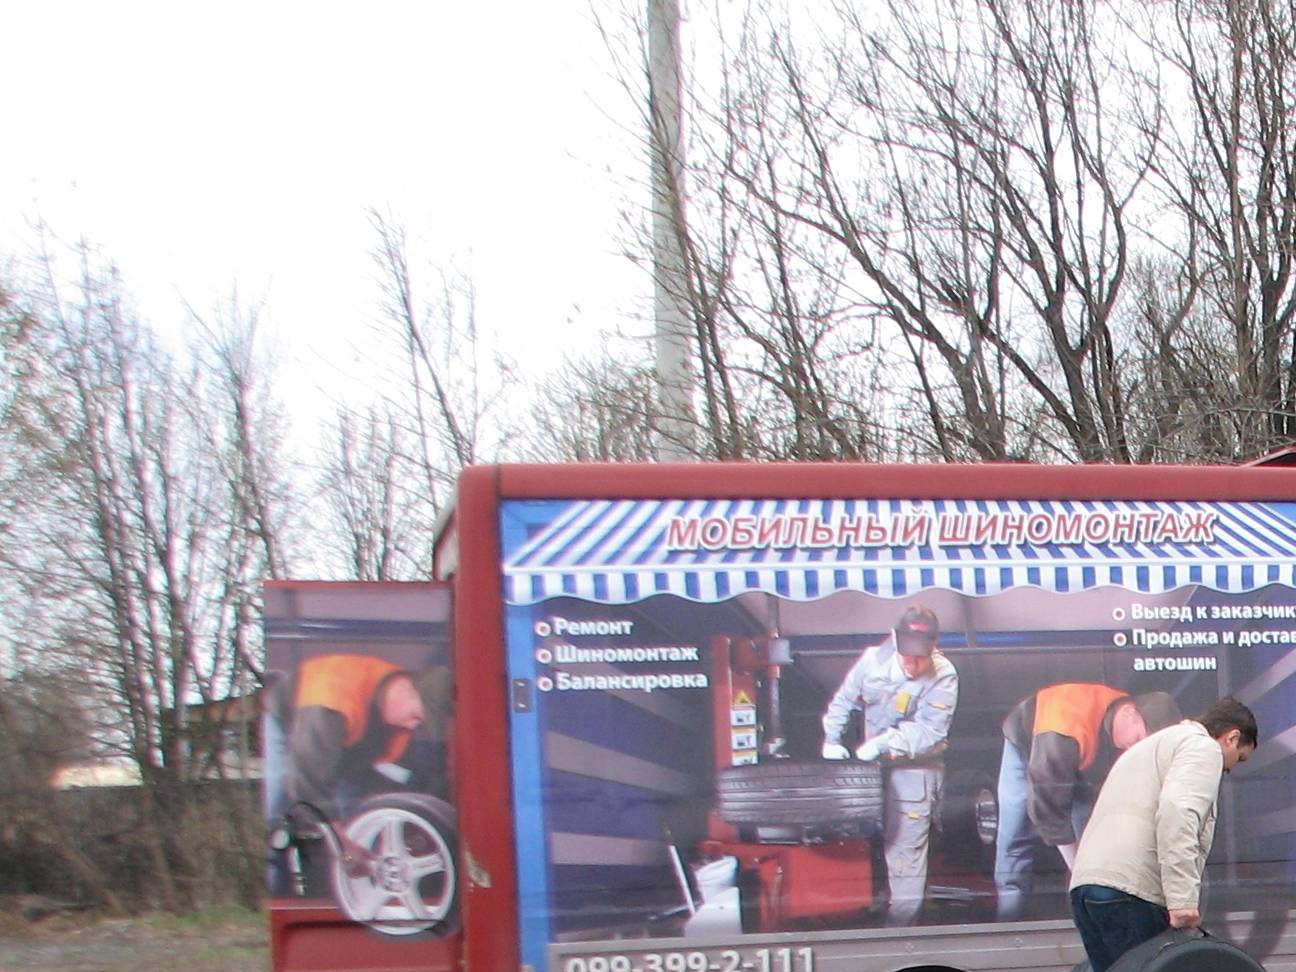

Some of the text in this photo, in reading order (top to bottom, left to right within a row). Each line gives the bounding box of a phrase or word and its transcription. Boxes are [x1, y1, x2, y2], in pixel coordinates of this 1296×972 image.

[666, 508, 1216, 550] МОБИЛЬНЫЙ ШИНОМОНТАЖ
[1131, 604, 1192, 623] Выезд
[1196, 607, 1207, 619] к
[555, 618, 634, 636] Ремонт
[1132, 629, 1218, 649] Продажа
[1223, 632, 1234, 644] и
[555, 644, 699, 664] Шиномонтаж
[1133, 655, 1217, 671] автошин
[556, 672, 708, 693] Балансировка
